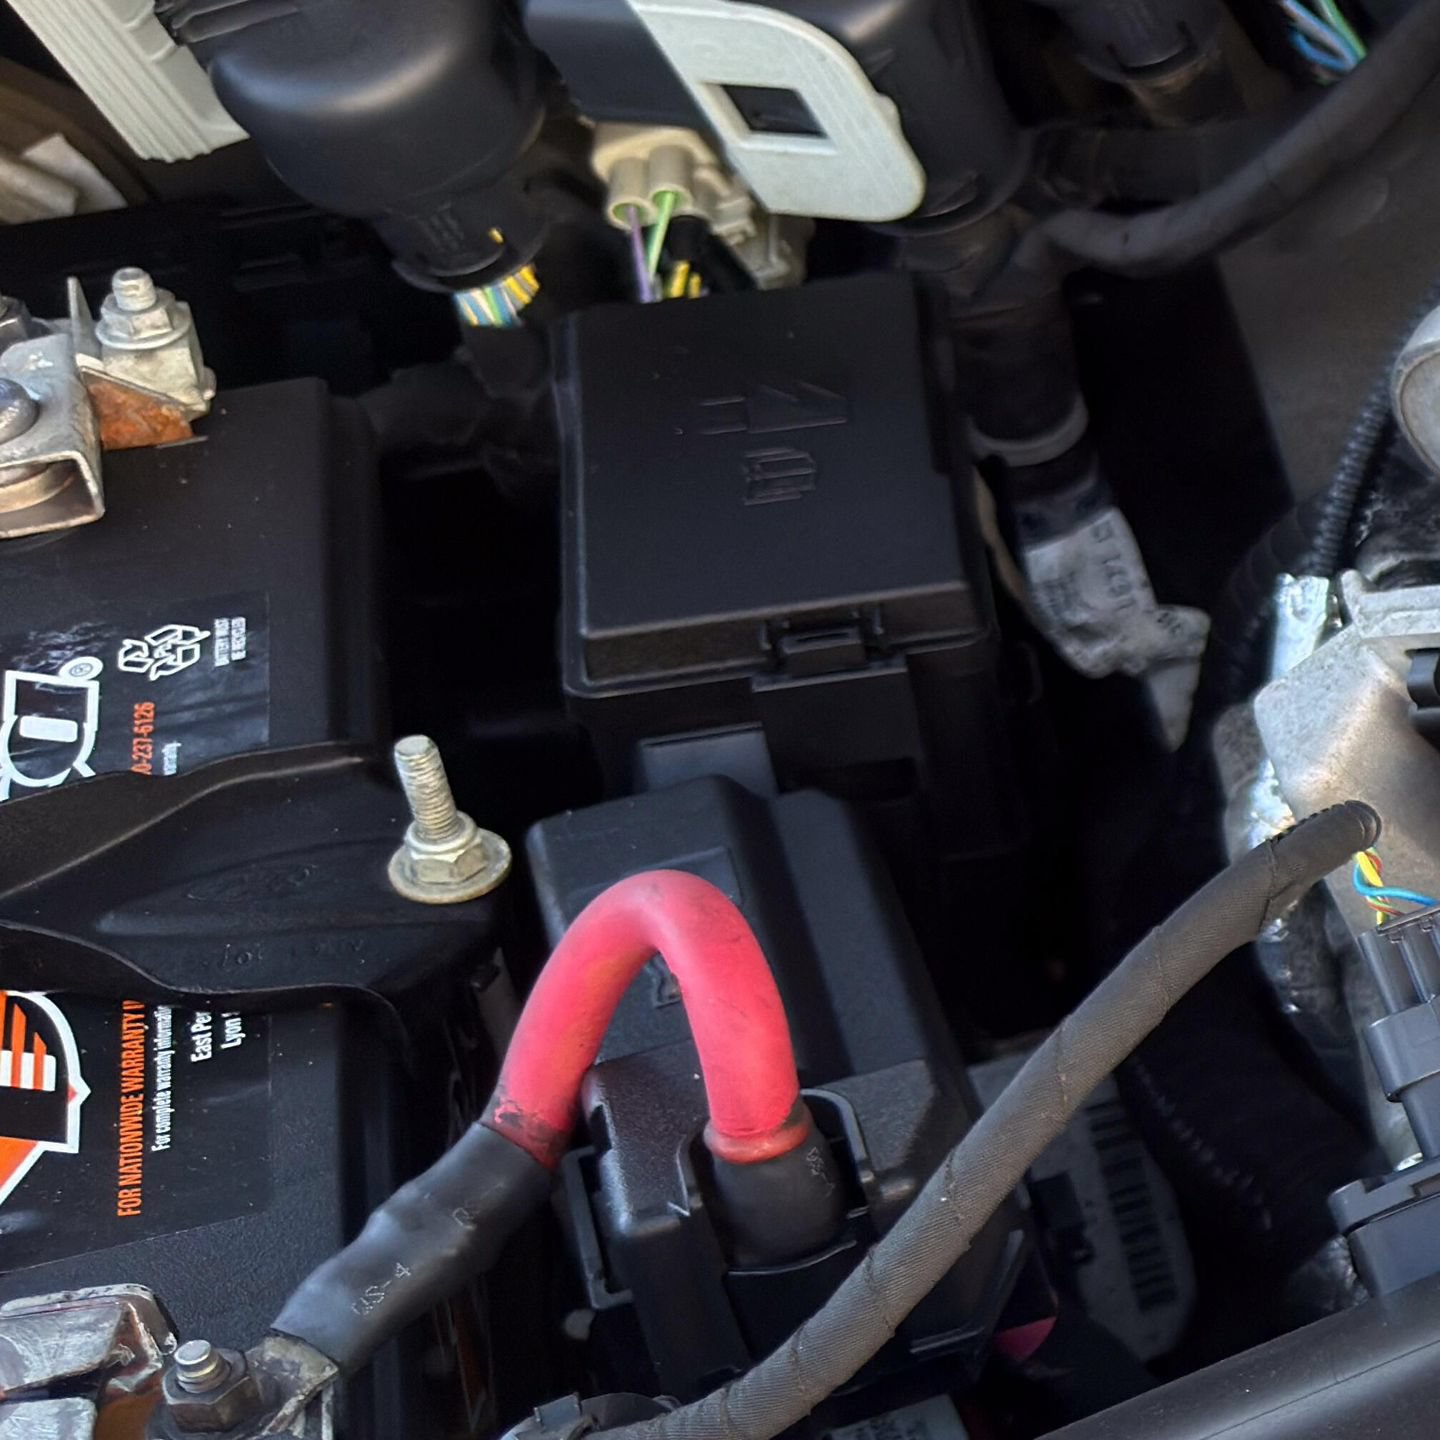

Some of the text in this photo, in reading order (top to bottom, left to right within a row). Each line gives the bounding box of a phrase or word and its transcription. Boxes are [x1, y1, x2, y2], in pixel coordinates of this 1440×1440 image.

[131, 702, 156, 775] 0-237-6126
[120, 1012, 145, 1093] WARRANTY
[190, 1032, 213, 1062] East
[221, 1018, 246, 1049] Lyon
[153, 1051, 175, 1090] warranty
[152, 1091, 175, 1133] complete
[118, 1094, 144, 1186] NATIONWIDE
[151, 1134, 171, 1151] For
[117, 1189, 142, 1216] FOR
